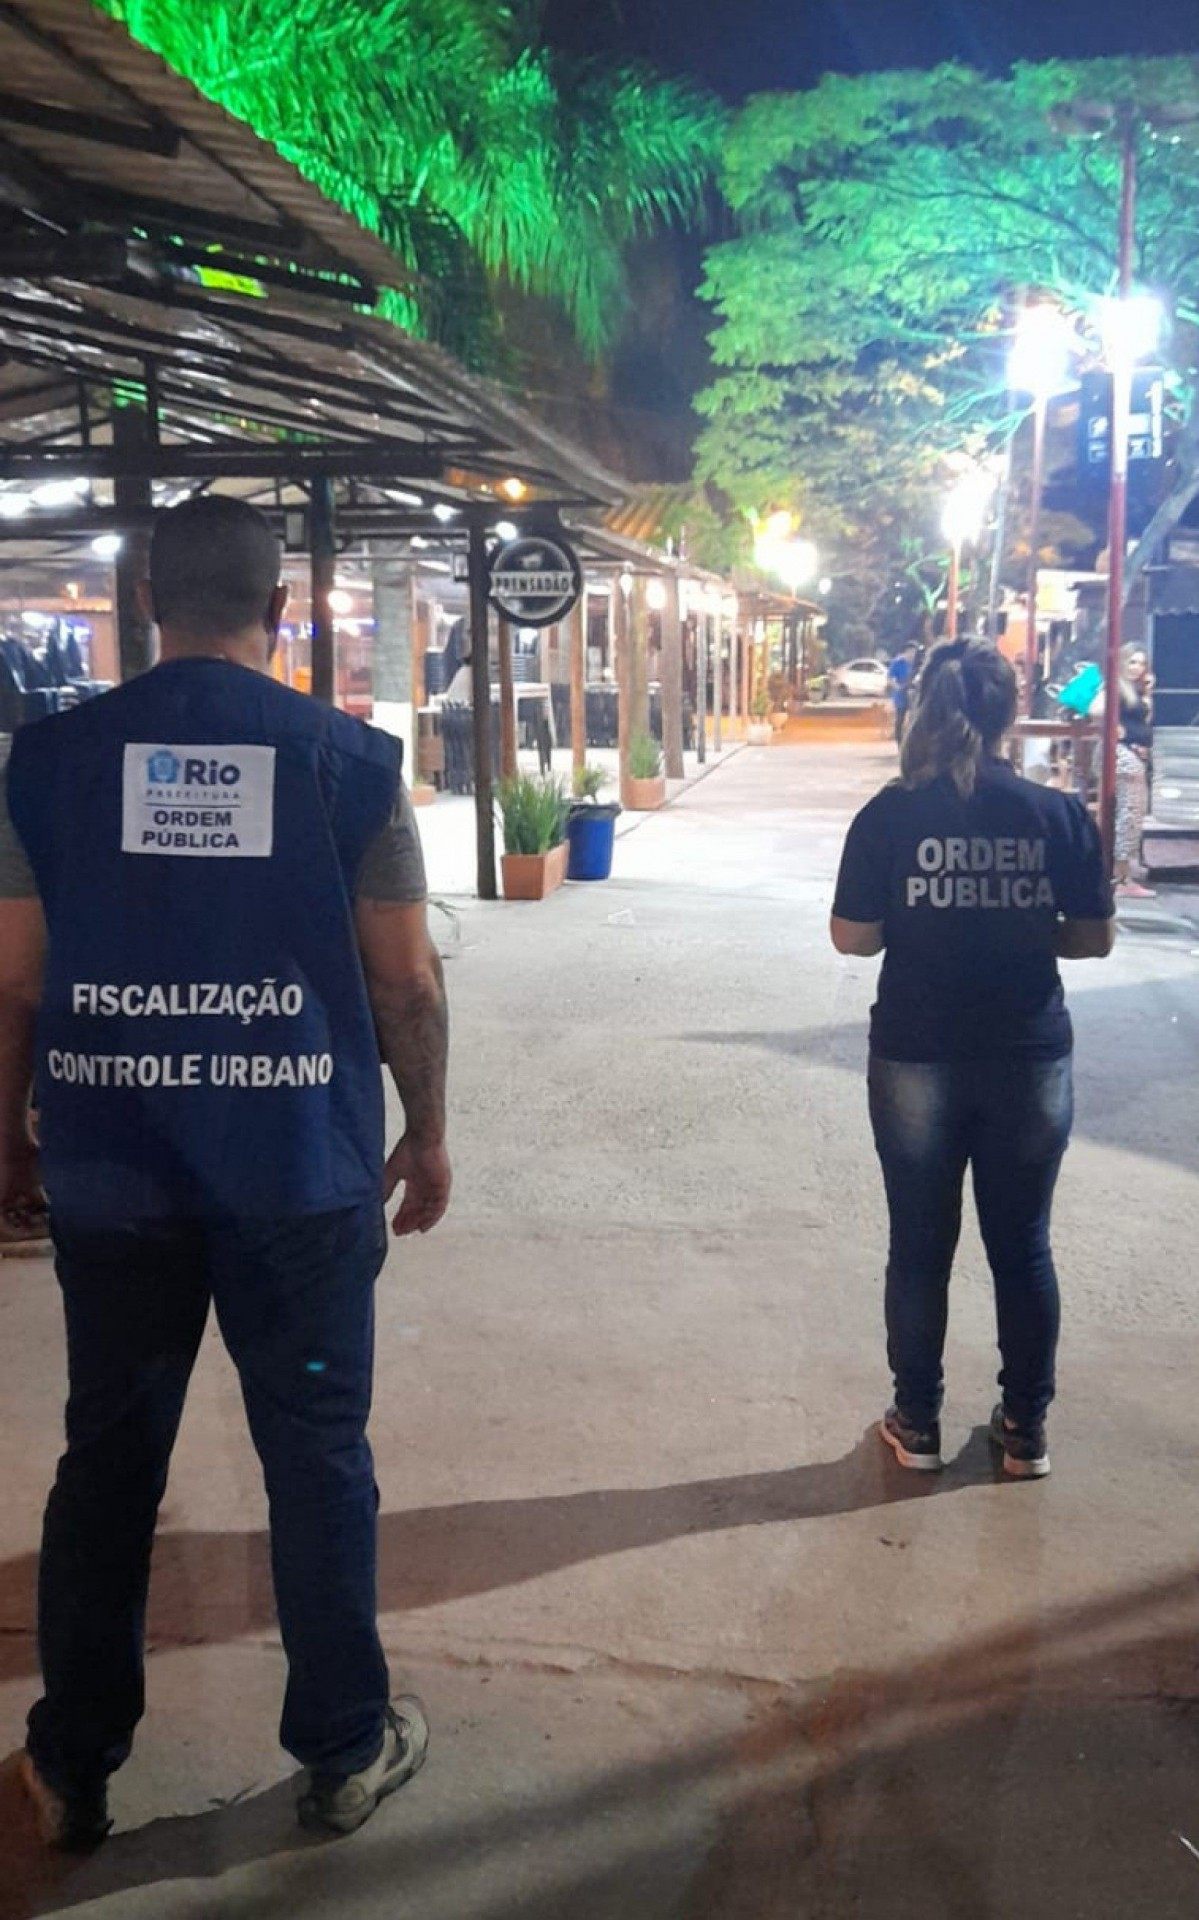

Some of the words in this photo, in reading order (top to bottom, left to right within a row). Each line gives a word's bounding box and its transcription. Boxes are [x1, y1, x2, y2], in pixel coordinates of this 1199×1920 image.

[184, 758, 240, 785] Rio
[154, 810, 232, 827] ORDEM
[141, 828, 239, 848] PÚBLICA
[917, 837, 1046, 872] ORDEM
[906, 871, 1054, 908] PÚBLICA
[72, 978, 303, 1025] FISCALIZAÇÃO
[48, 1049, 203, 1088] CONTROLE
[210, 1053, 334, 1088] URBANO
